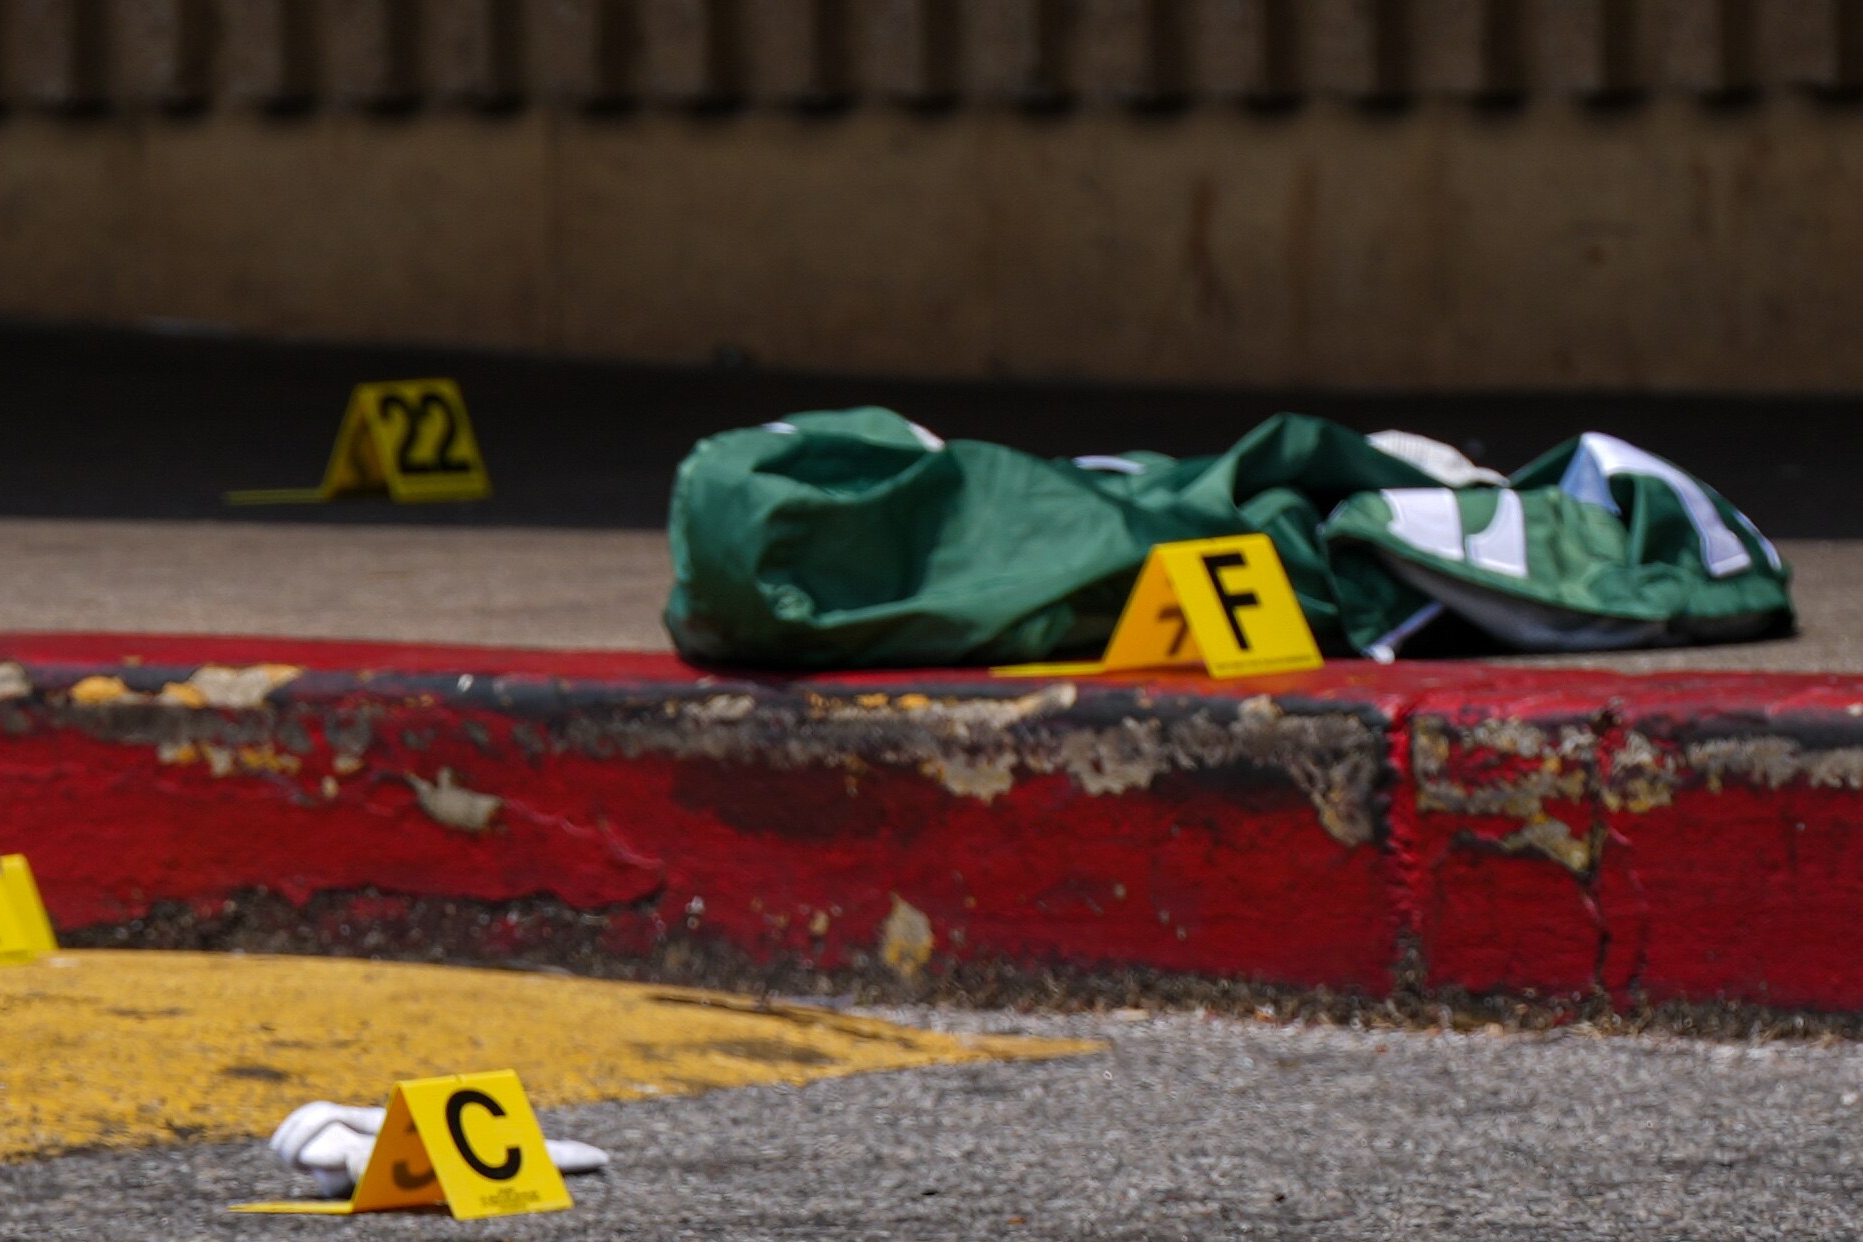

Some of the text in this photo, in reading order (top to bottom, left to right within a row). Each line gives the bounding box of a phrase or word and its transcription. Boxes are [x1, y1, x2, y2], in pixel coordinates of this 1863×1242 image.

[378, 393, 471, 475] 22
[1201, 552, 1260, 651] F
[445, 1089, 522, 1181] C
